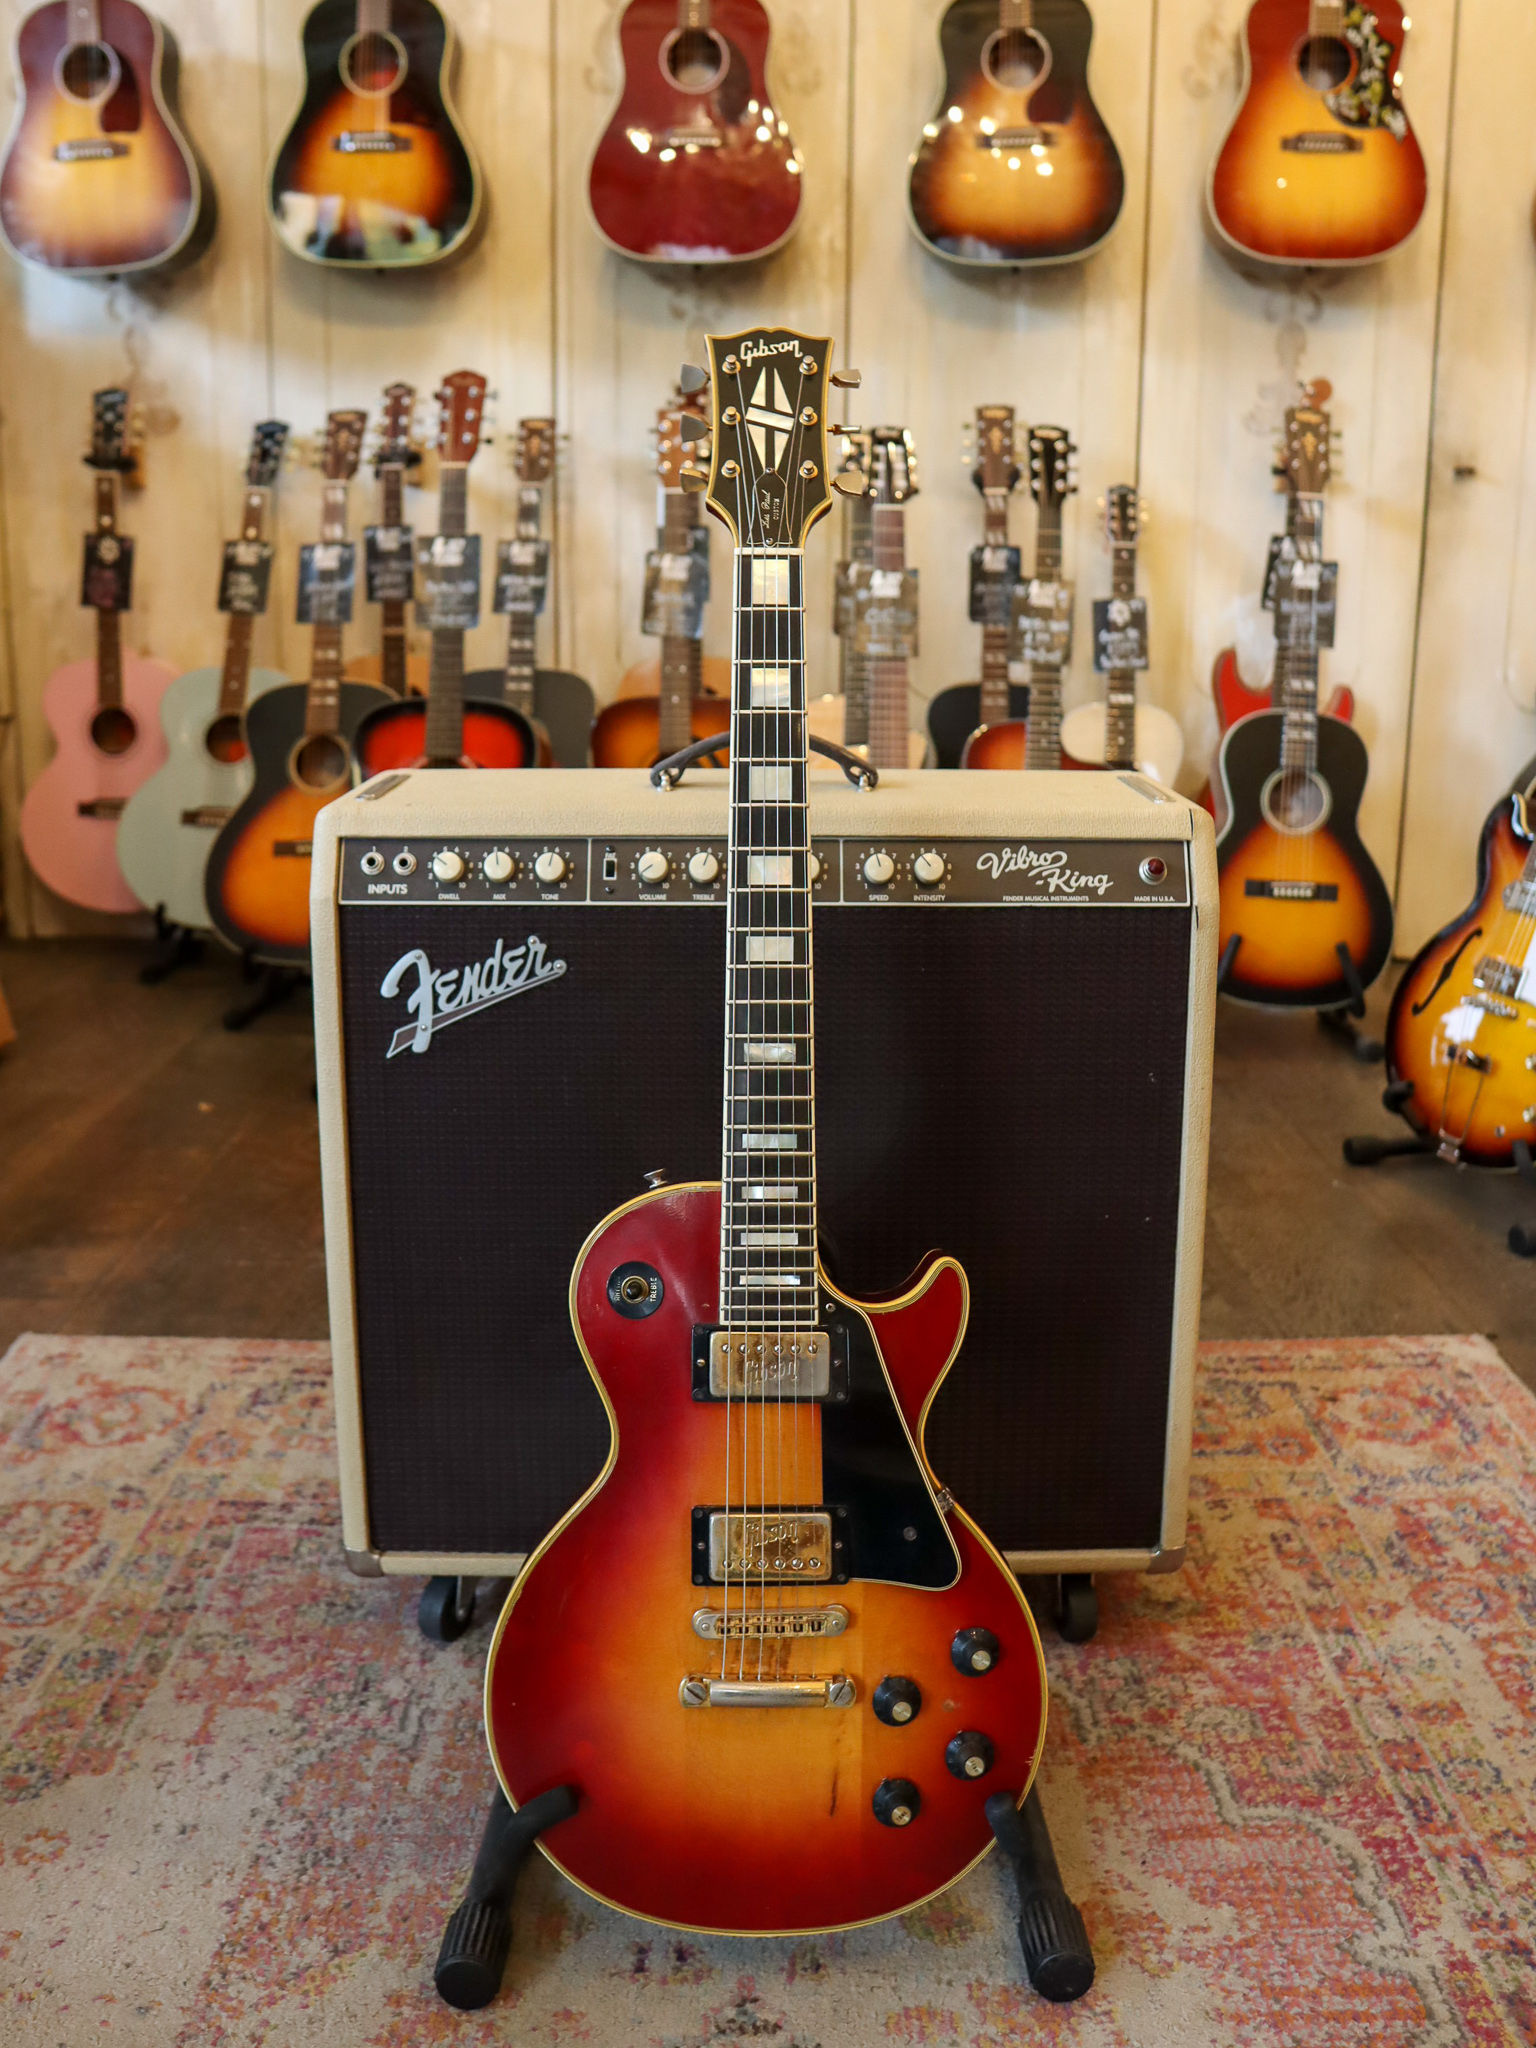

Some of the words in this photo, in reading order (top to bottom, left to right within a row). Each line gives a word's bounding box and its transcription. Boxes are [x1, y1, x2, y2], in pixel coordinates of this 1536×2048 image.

[740, 339, 803, 368] Gibson
[760, 489, 771, 510] Paul
[760, 513, 770, 529] Les
[976, 845, 1068, 879] Vibro
[367, 883, 409, 895] INPUTS
[380, 935, 567, 1054] Fender
